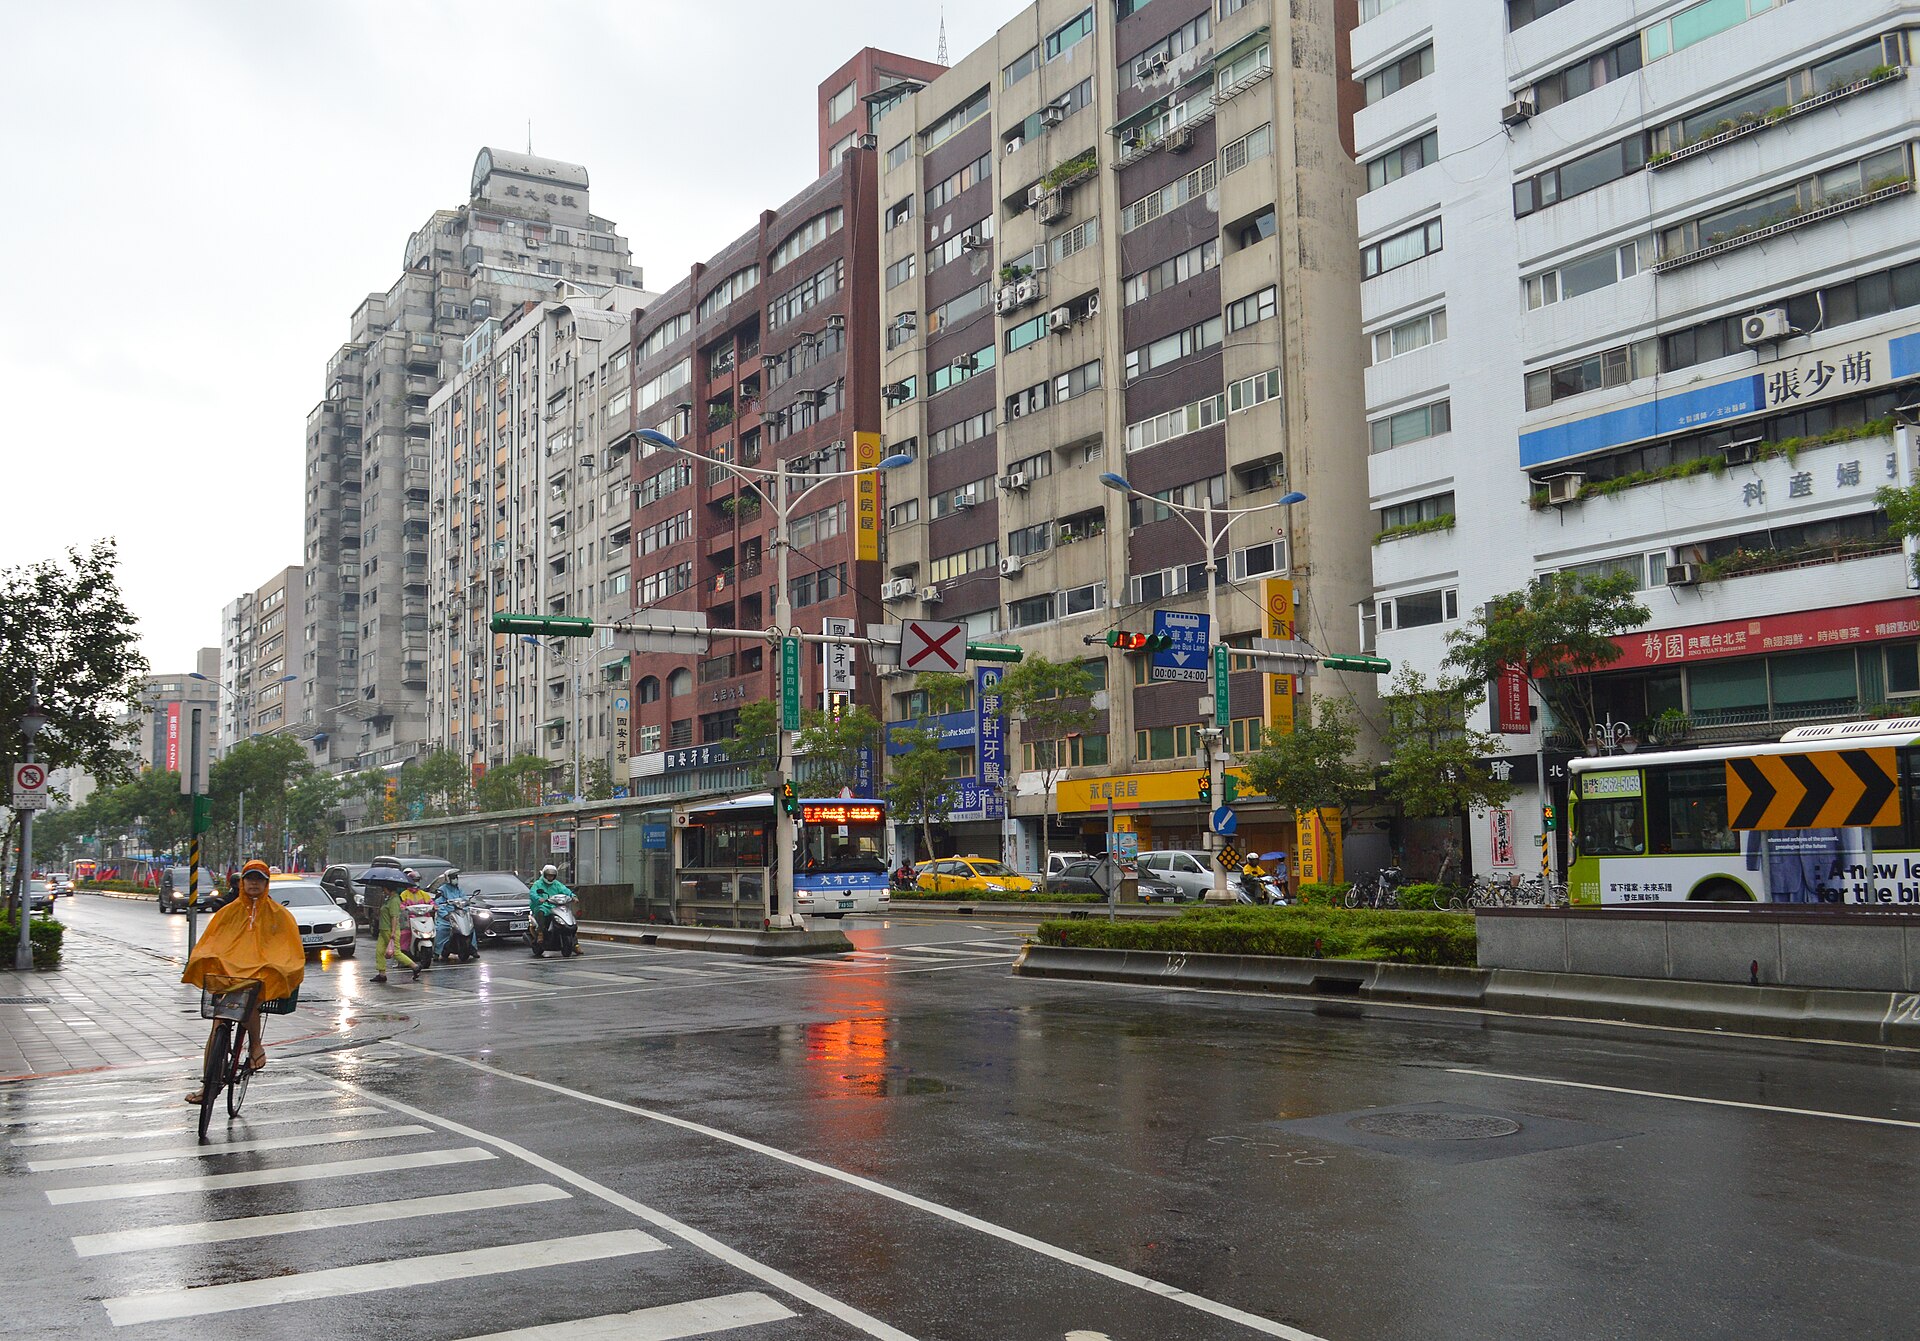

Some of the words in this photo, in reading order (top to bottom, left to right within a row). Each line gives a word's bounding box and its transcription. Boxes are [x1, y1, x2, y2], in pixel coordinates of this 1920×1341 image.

[1767, 350, 1872, 405] 張少萌
[860, 462, 874, 530] 永慶房屋
[1273, 619, 1289, 696] 永屋
[1688, 631, 1746, 650] 典藏台北菜
[1763, 632, 1804, 649] 魚翅海鮮
[786, 645, 795, 697] 信義路四段
[1218, 653, 1226, 697] 信義路四段
[982, 695, 1000, 784] 康軒牙醫
[1089, 780, 1139, 800] 永慶房屋
[1301, 817, 1314, 878] 永慶房屋
[820, 875, 871, 886] 大有巴士
[1816, 882, 1849, 903] for
[1853, 882, 1893, 903] the
[1849, 863, 1898, 880] new
